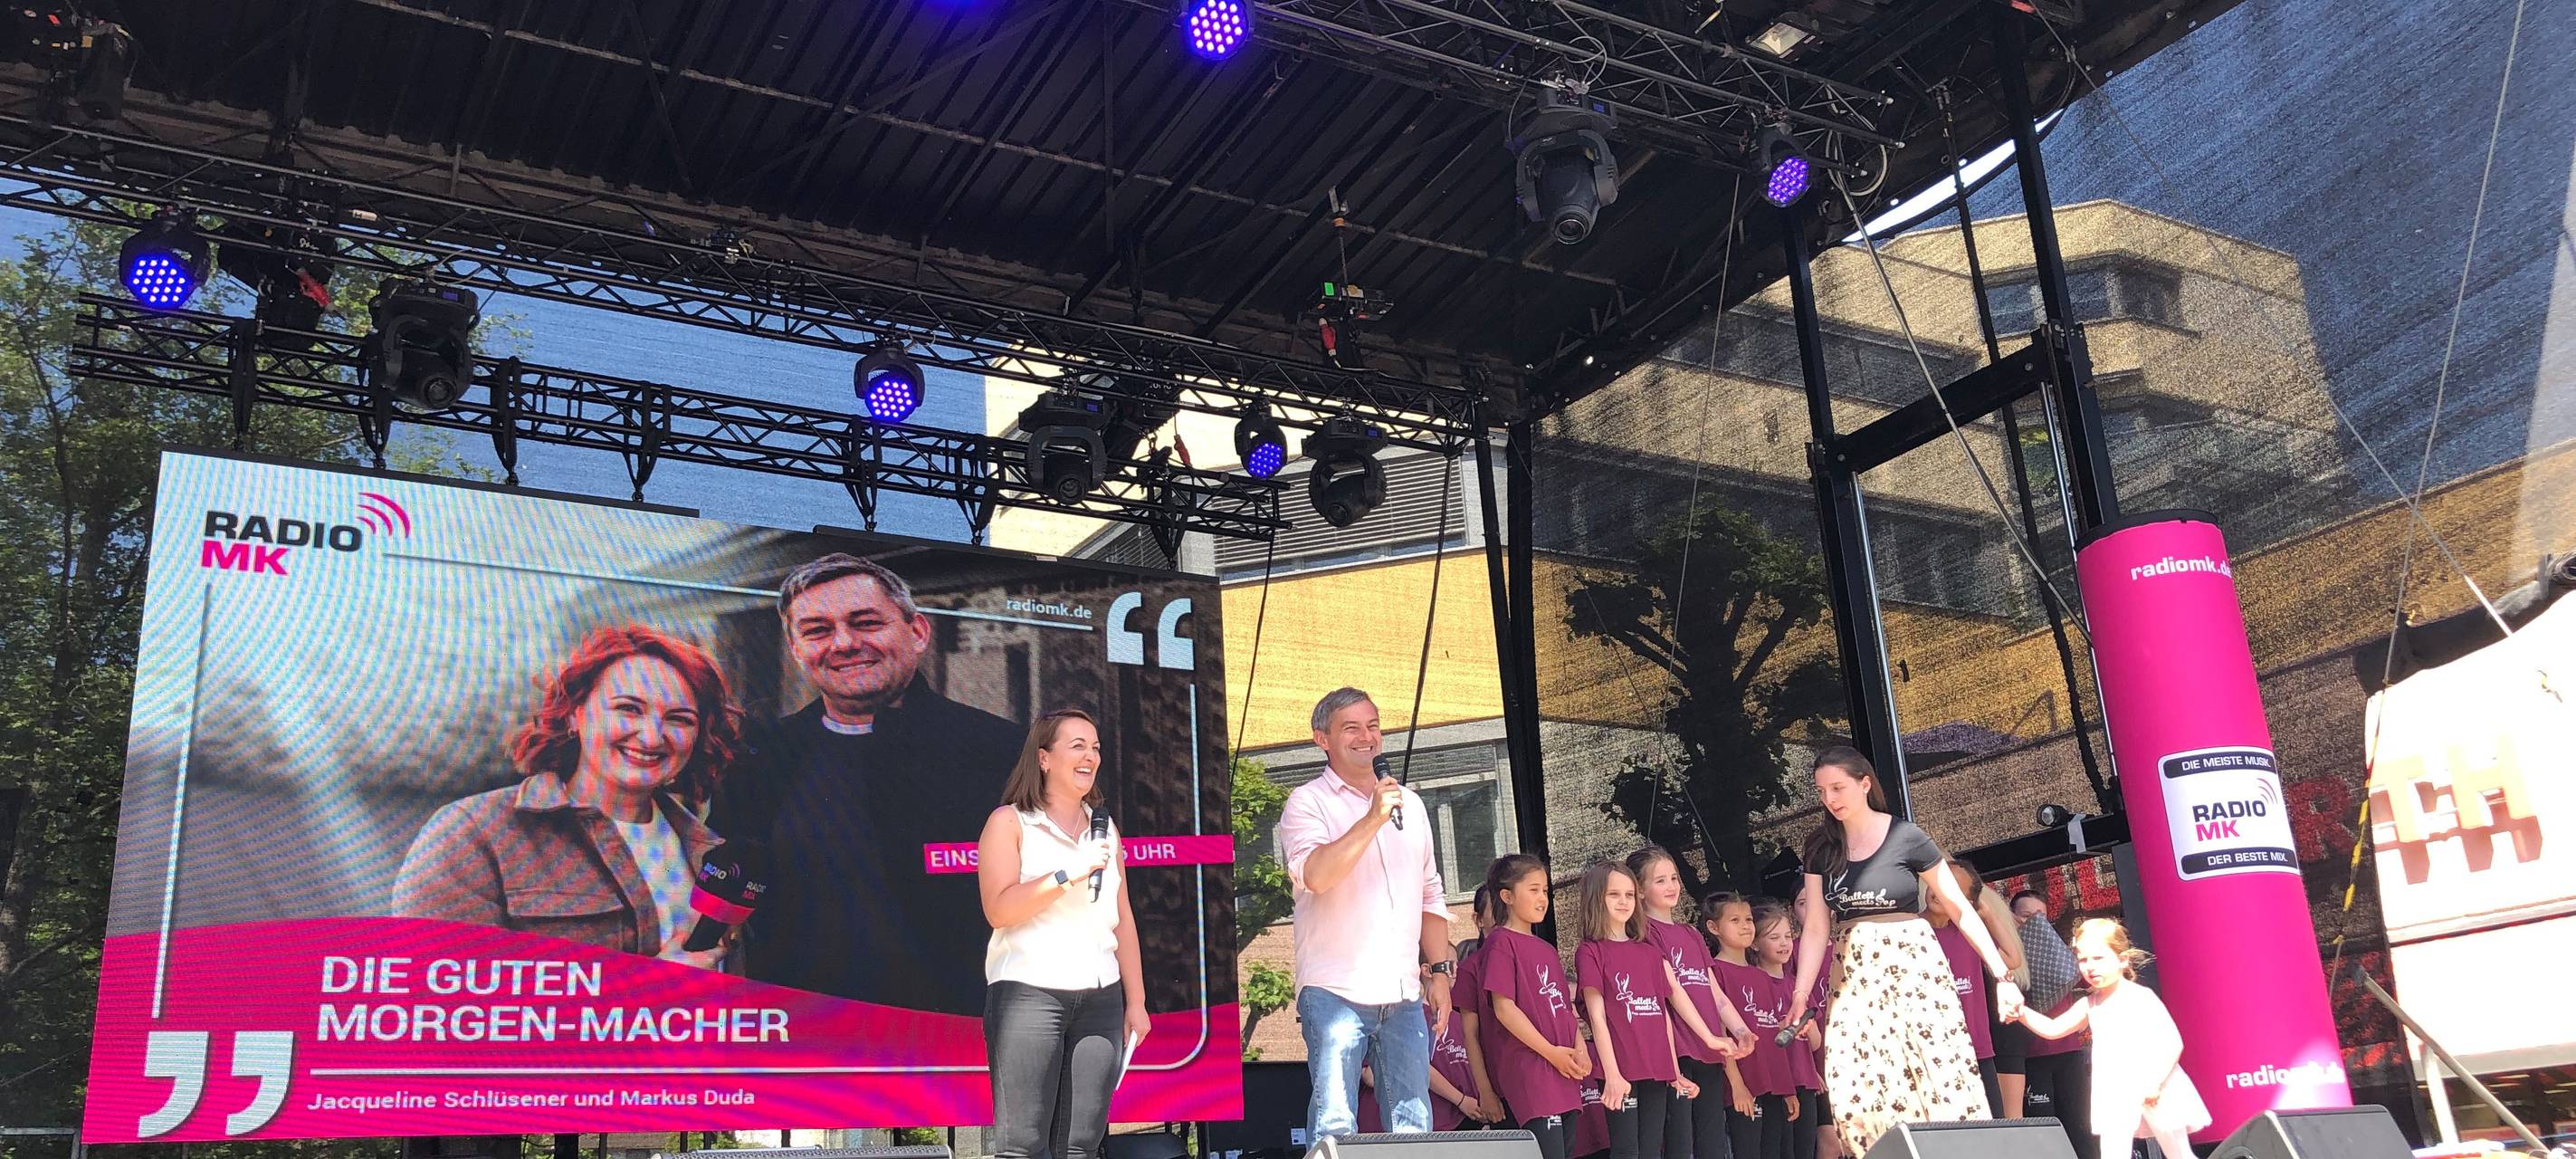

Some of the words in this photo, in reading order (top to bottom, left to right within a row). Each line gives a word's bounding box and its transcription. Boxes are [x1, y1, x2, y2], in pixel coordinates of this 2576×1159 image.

[204, 510, 363, 552] RADIO
[201, 540, 289, 576] MK
[1007, 598, 1092, 619] radiomk.de
[2181, 759, 2200, 771] DIE
[2203, 755, 2243, 768] MEISTE
[2192, 800, 2266, 822] RADIO
[2195, 819, 2240, 842] MK
[1133, 843, 1176, 860] UHR
[2207, 855, 2232, 866] DER
[2235, 851, 2268, 863] BESTE
[321, 955, 412, 994] DIE
[426, 958, 602, 997] GUTEN
[317, 1003, 790, 1043] MORGEN-MACHER
[308, 1090, 437, 1114] Jacqueline
[444, 1089, 568, 1108] Schlüsener
[574, 1089, 614, 1106] und
[621, 1088, 697, 1106] Markus
[704, 1088, 755, 1106] Duda
